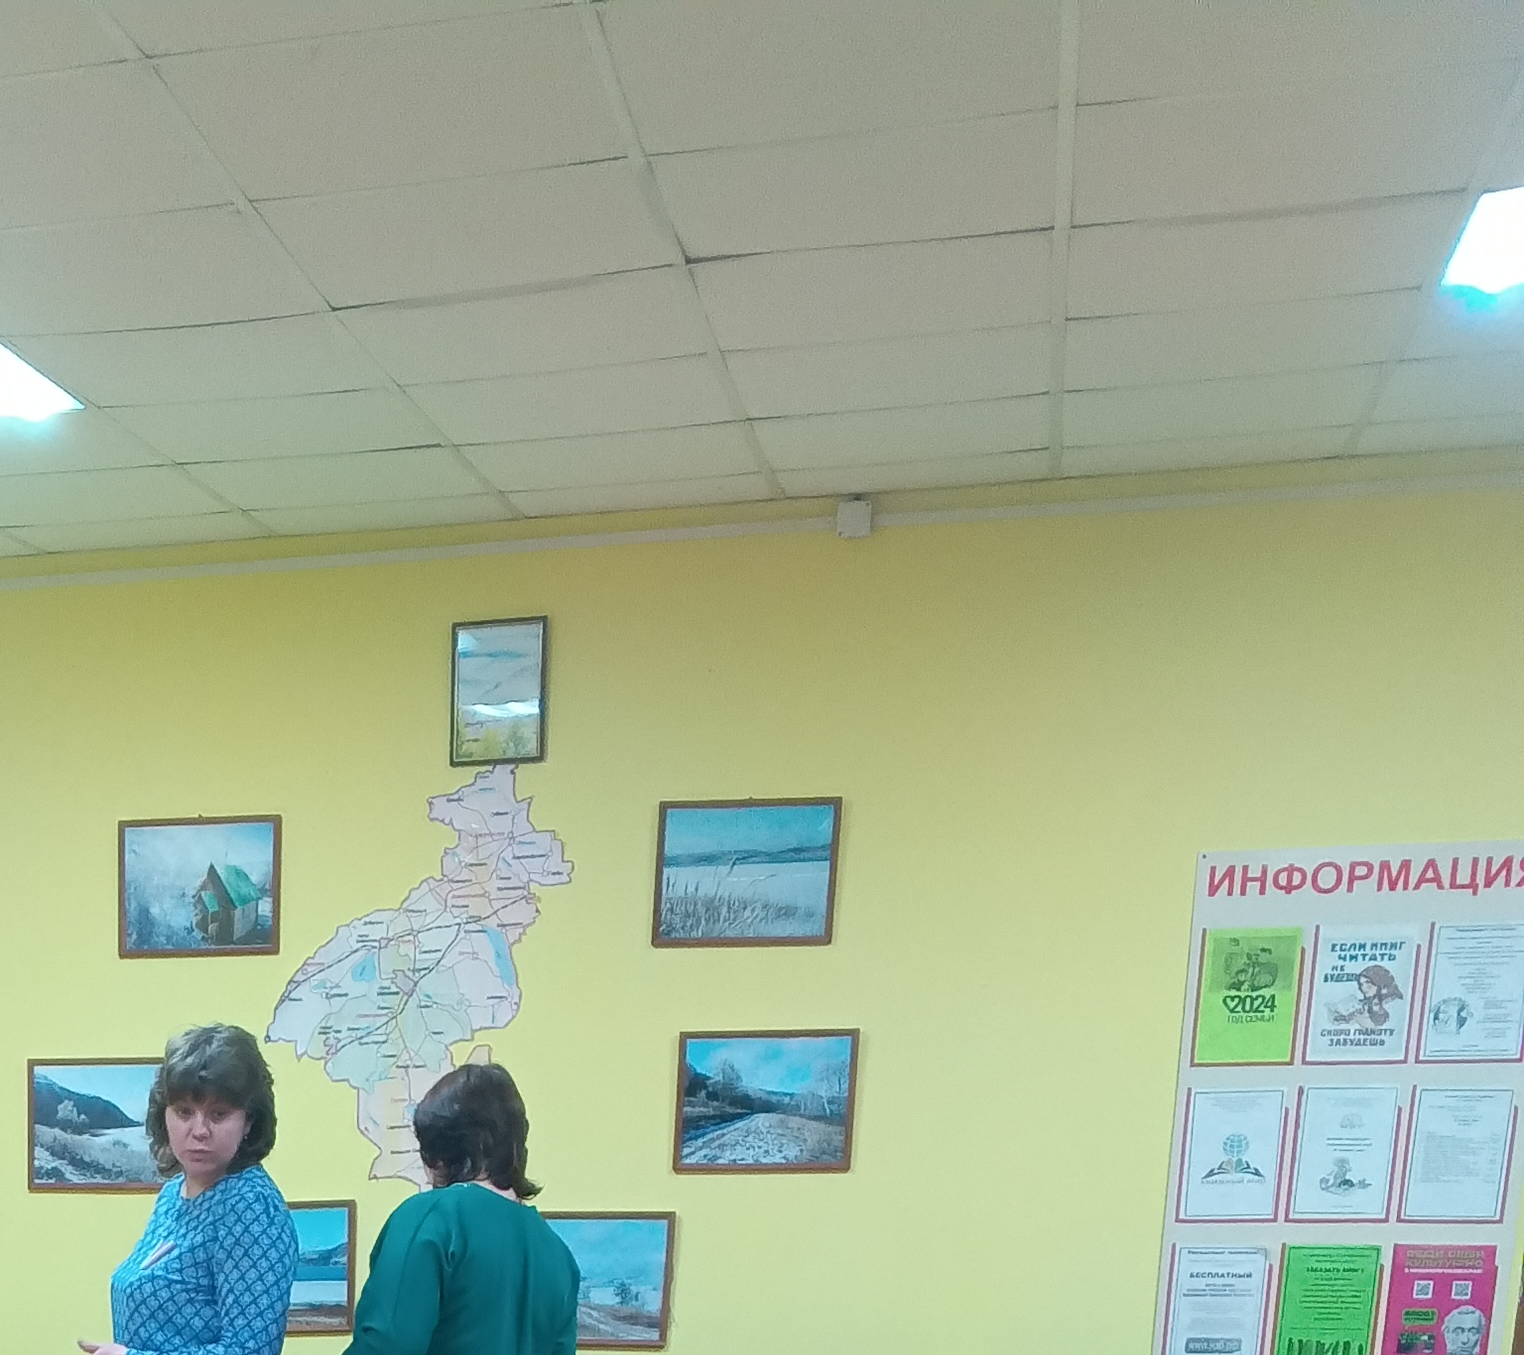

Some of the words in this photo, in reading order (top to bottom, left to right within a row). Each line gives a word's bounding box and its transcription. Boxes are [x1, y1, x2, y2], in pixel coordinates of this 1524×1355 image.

[1330, 942, 1367, 953] ЕСЛИ
[1338, 953, 1397, 962] ЧИТАТЬ
[1230, 993, 1277, 1013] 2024
[1328, 1038, 1386, 1047] ЗАБУДЕШЬ
[1189, 1271, 1253, 1279] БЕСПЛАТНЫЙ
